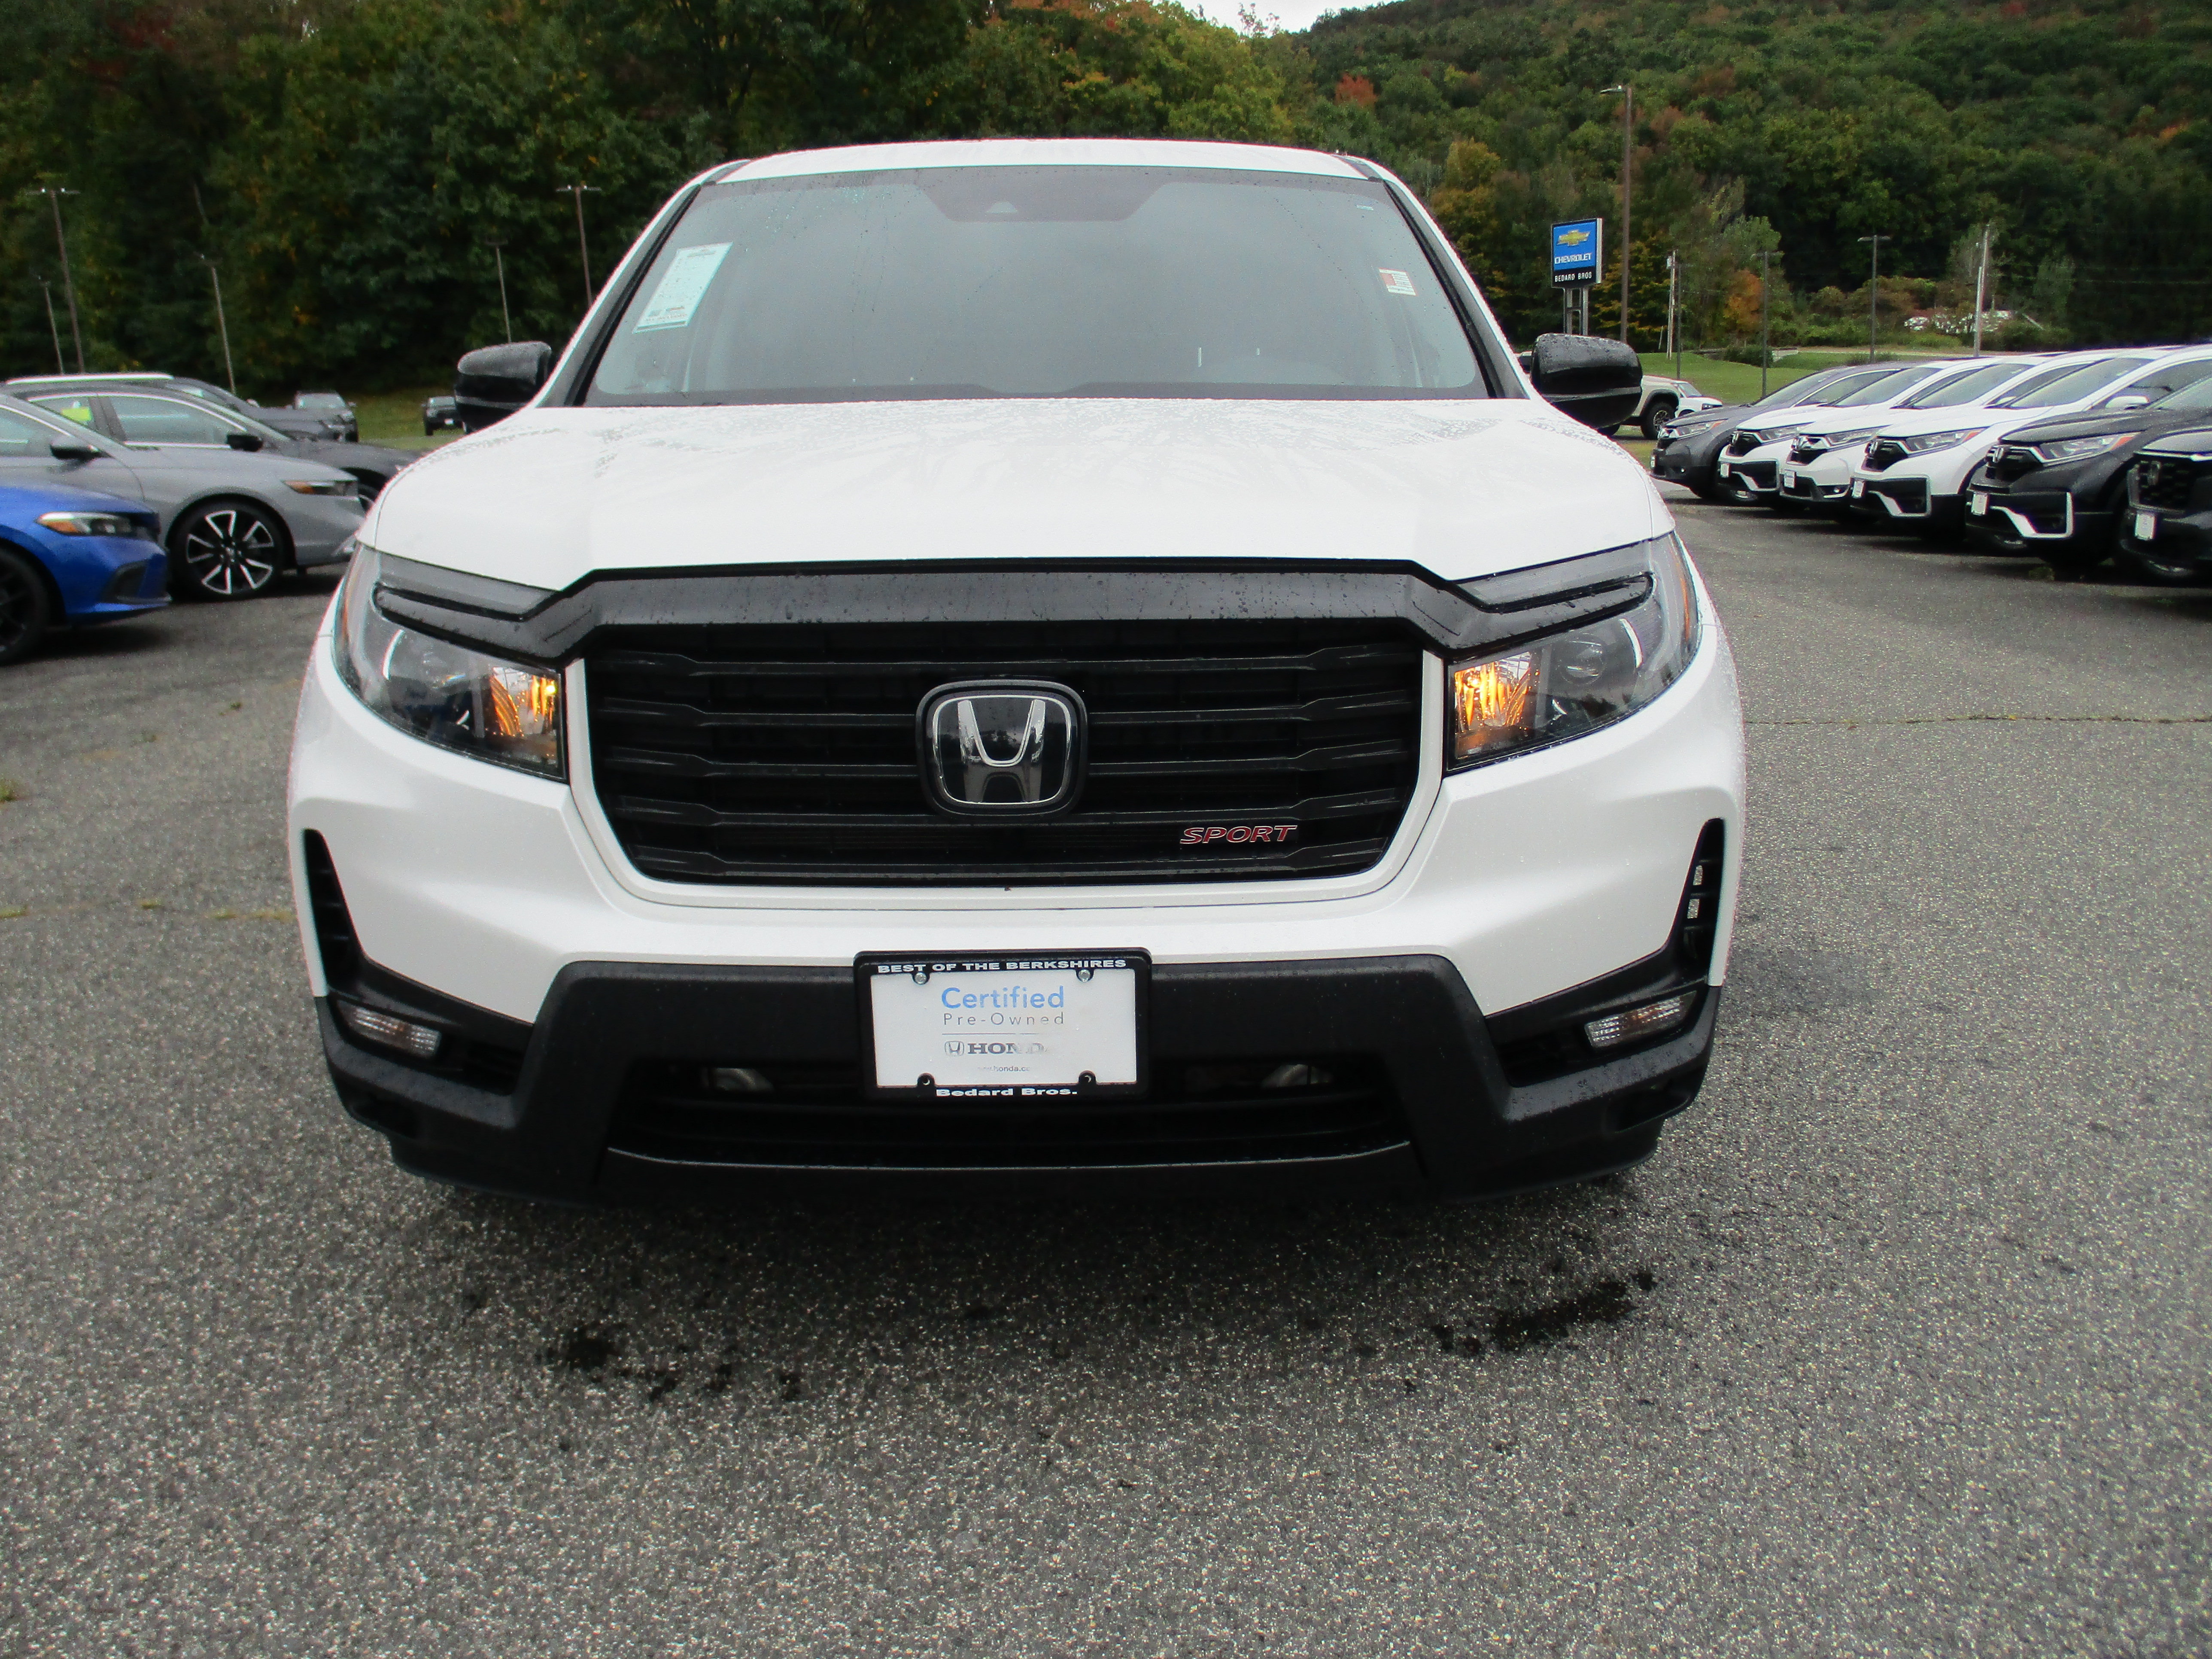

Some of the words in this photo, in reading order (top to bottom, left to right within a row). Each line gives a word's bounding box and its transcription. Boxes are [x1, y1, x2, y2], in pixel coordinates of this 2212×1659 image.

[1554, 252, 1592, 264] CHEVROLET
[1554, 273, 1575, 282] BEDARD
[1578, 271, 1592, 280] BROS
[1180, 825, 1297, 844] SPORT
[878, 964, 926, 973] BEST
[962, 963, 1000, 971] THE
[1006, 960, 1127, 969] BERKSHIRES
[942, 985, 1064, 1009] Certified
[944, 1012, 1064, 1025] Pre-Owned
[967, 1042, 1048, 1054] HOND
[936, 1088, 1013, 1097] Bedard
[1021, 1088, 1078, 1096] Bros.
